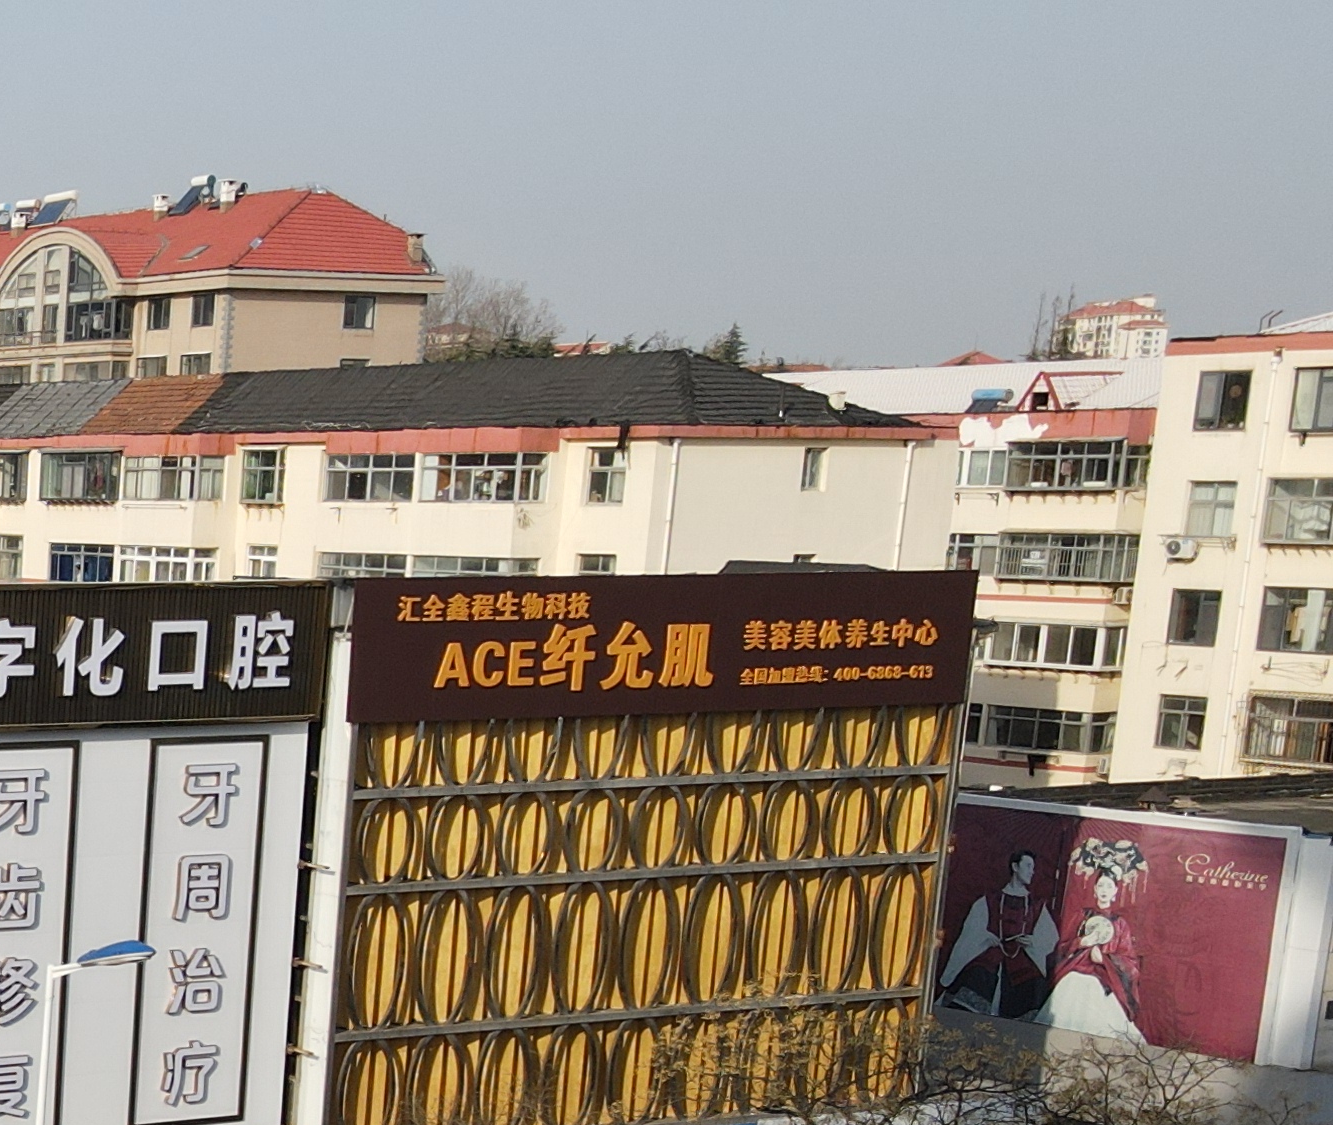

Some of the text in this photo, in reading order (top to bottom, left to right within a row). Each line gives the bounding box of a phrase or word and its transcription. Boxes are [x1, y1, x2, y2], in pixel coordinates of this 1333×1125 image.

[397, 590, 591, 622] 汇全鑫程生物科技
[742, 618, 939, 652] 美容美体养生中心
[433, 621, 715, 691] ACE纤允肌
[1178, 852, 1269, 884] Catherine
[161, 762, 239, 1107] 牙周治疗
